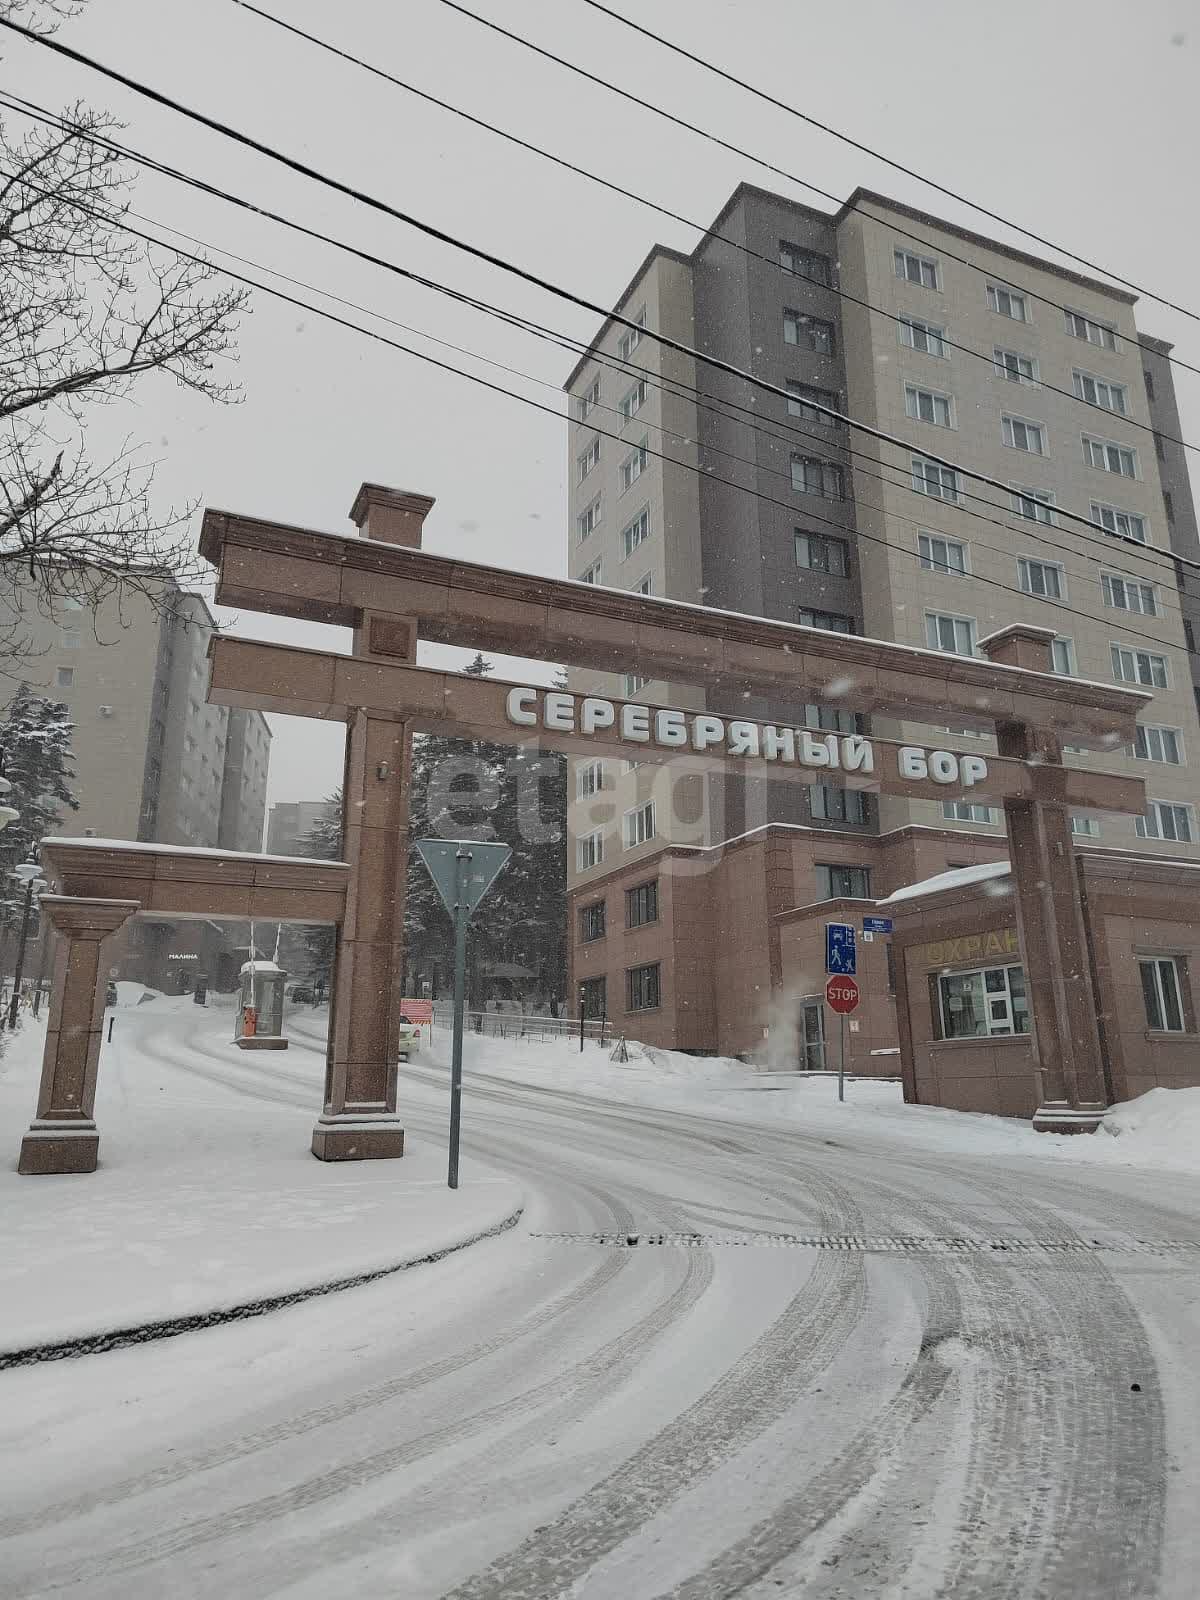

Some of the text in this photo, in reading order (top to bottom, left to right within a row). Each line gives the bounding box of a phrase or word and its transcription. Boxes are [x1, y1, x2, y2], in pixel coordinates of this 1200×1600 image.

[506, 687, 988, 788] СЕРЕБРЯНЫЙ БОР
[828, 987, 858, 1001] STOP
